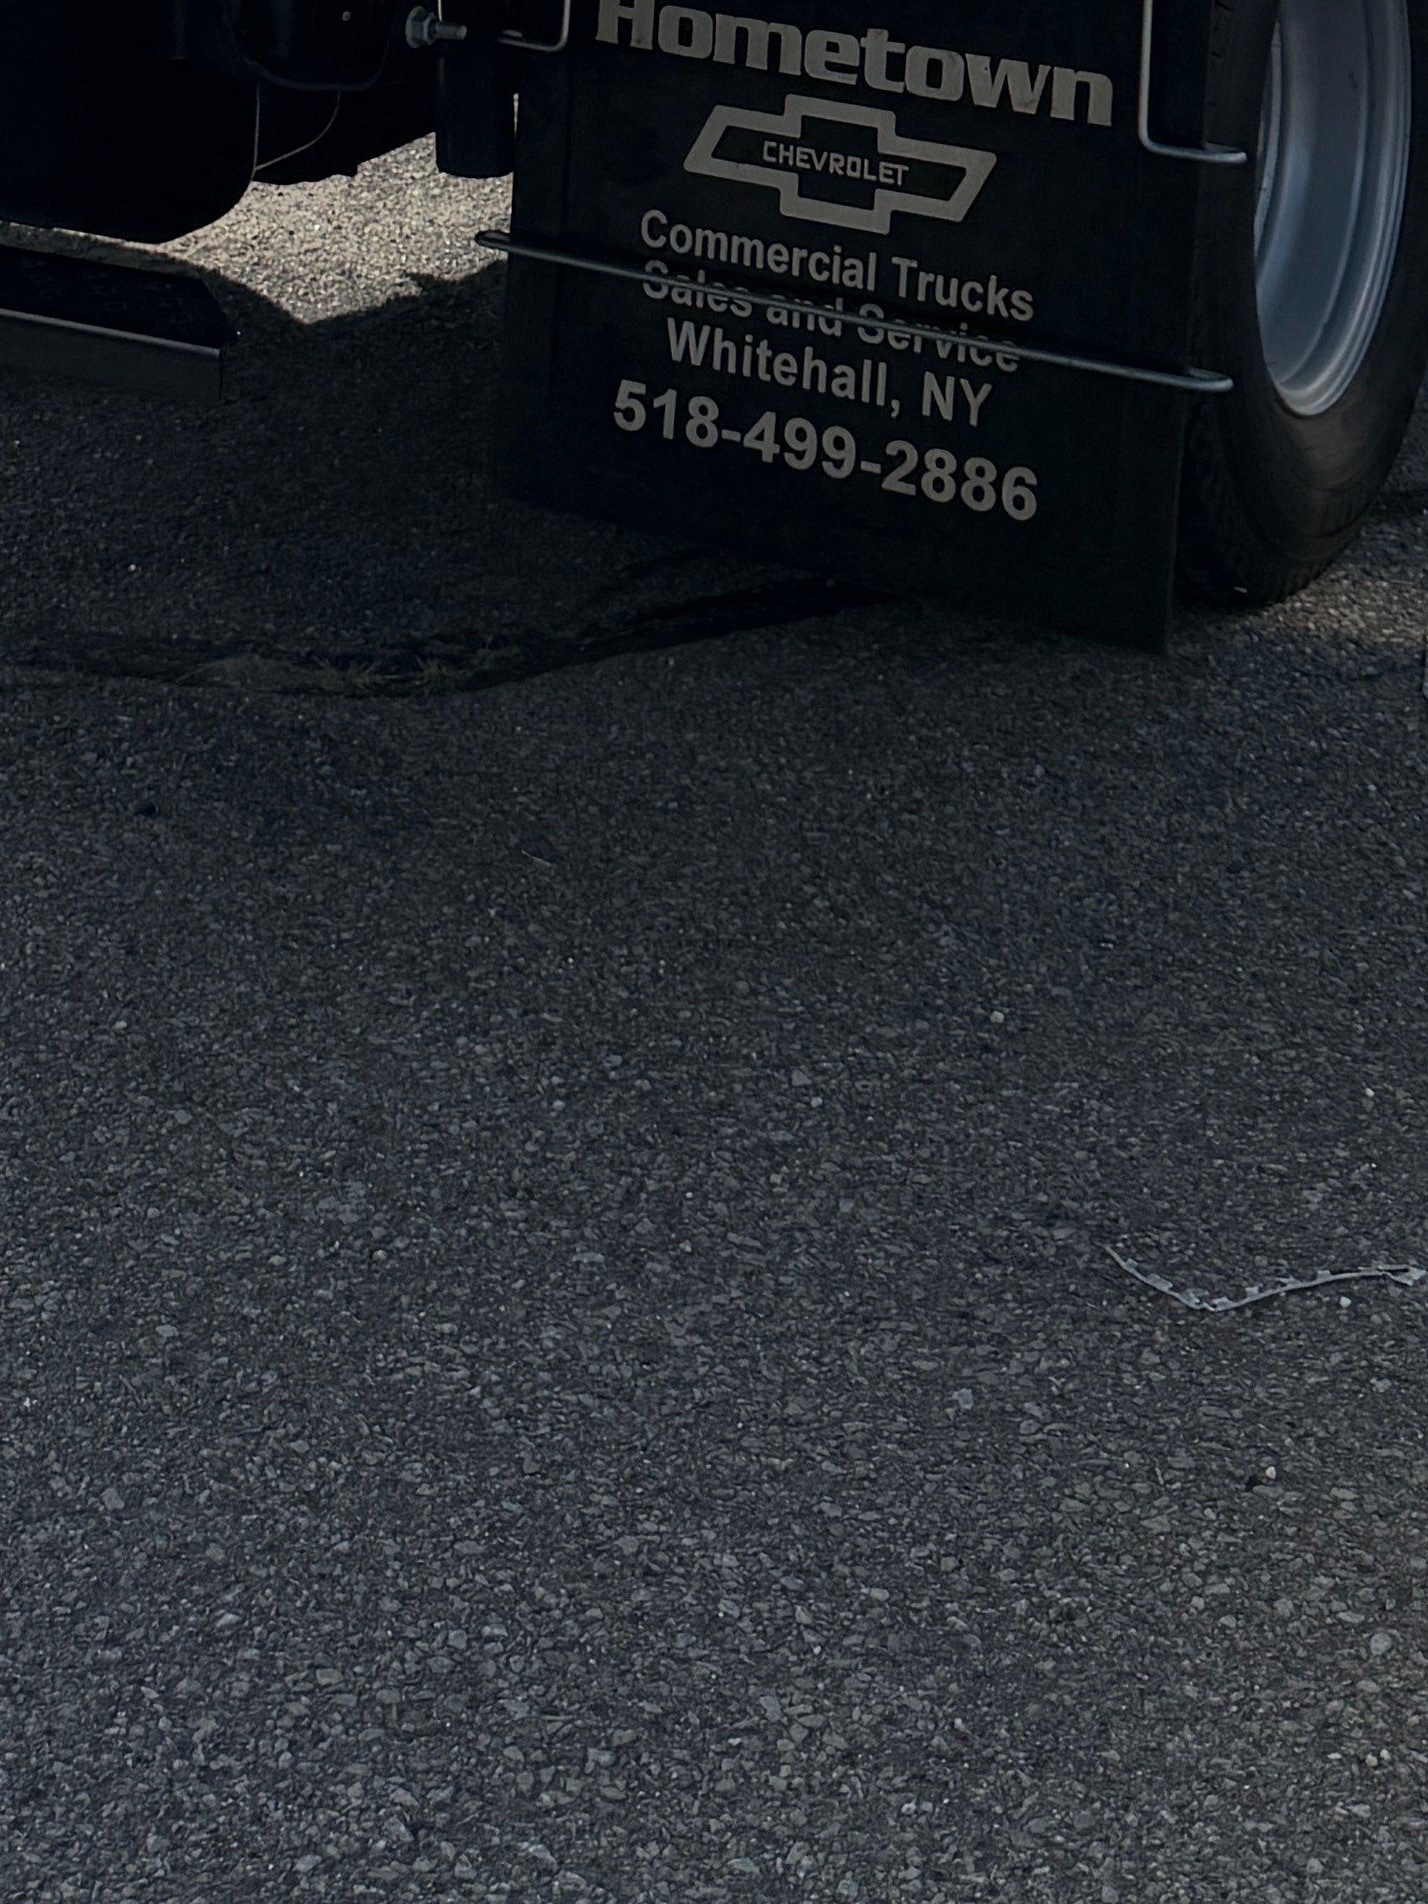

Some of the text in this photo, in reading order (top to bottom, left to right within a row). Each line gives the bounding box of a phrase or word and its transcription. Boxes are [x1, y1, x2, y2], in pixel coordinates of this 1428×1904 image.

[760, 139, 911, 188] CHEVROLET
[639, 208, 1035, 323] Commercial Trucks
[641, 259, 1021, 374] Sales and Service
[665, 316, 994, 428] Whitehall, NY
[612, 378, 1039, 522] 518-499-2886
